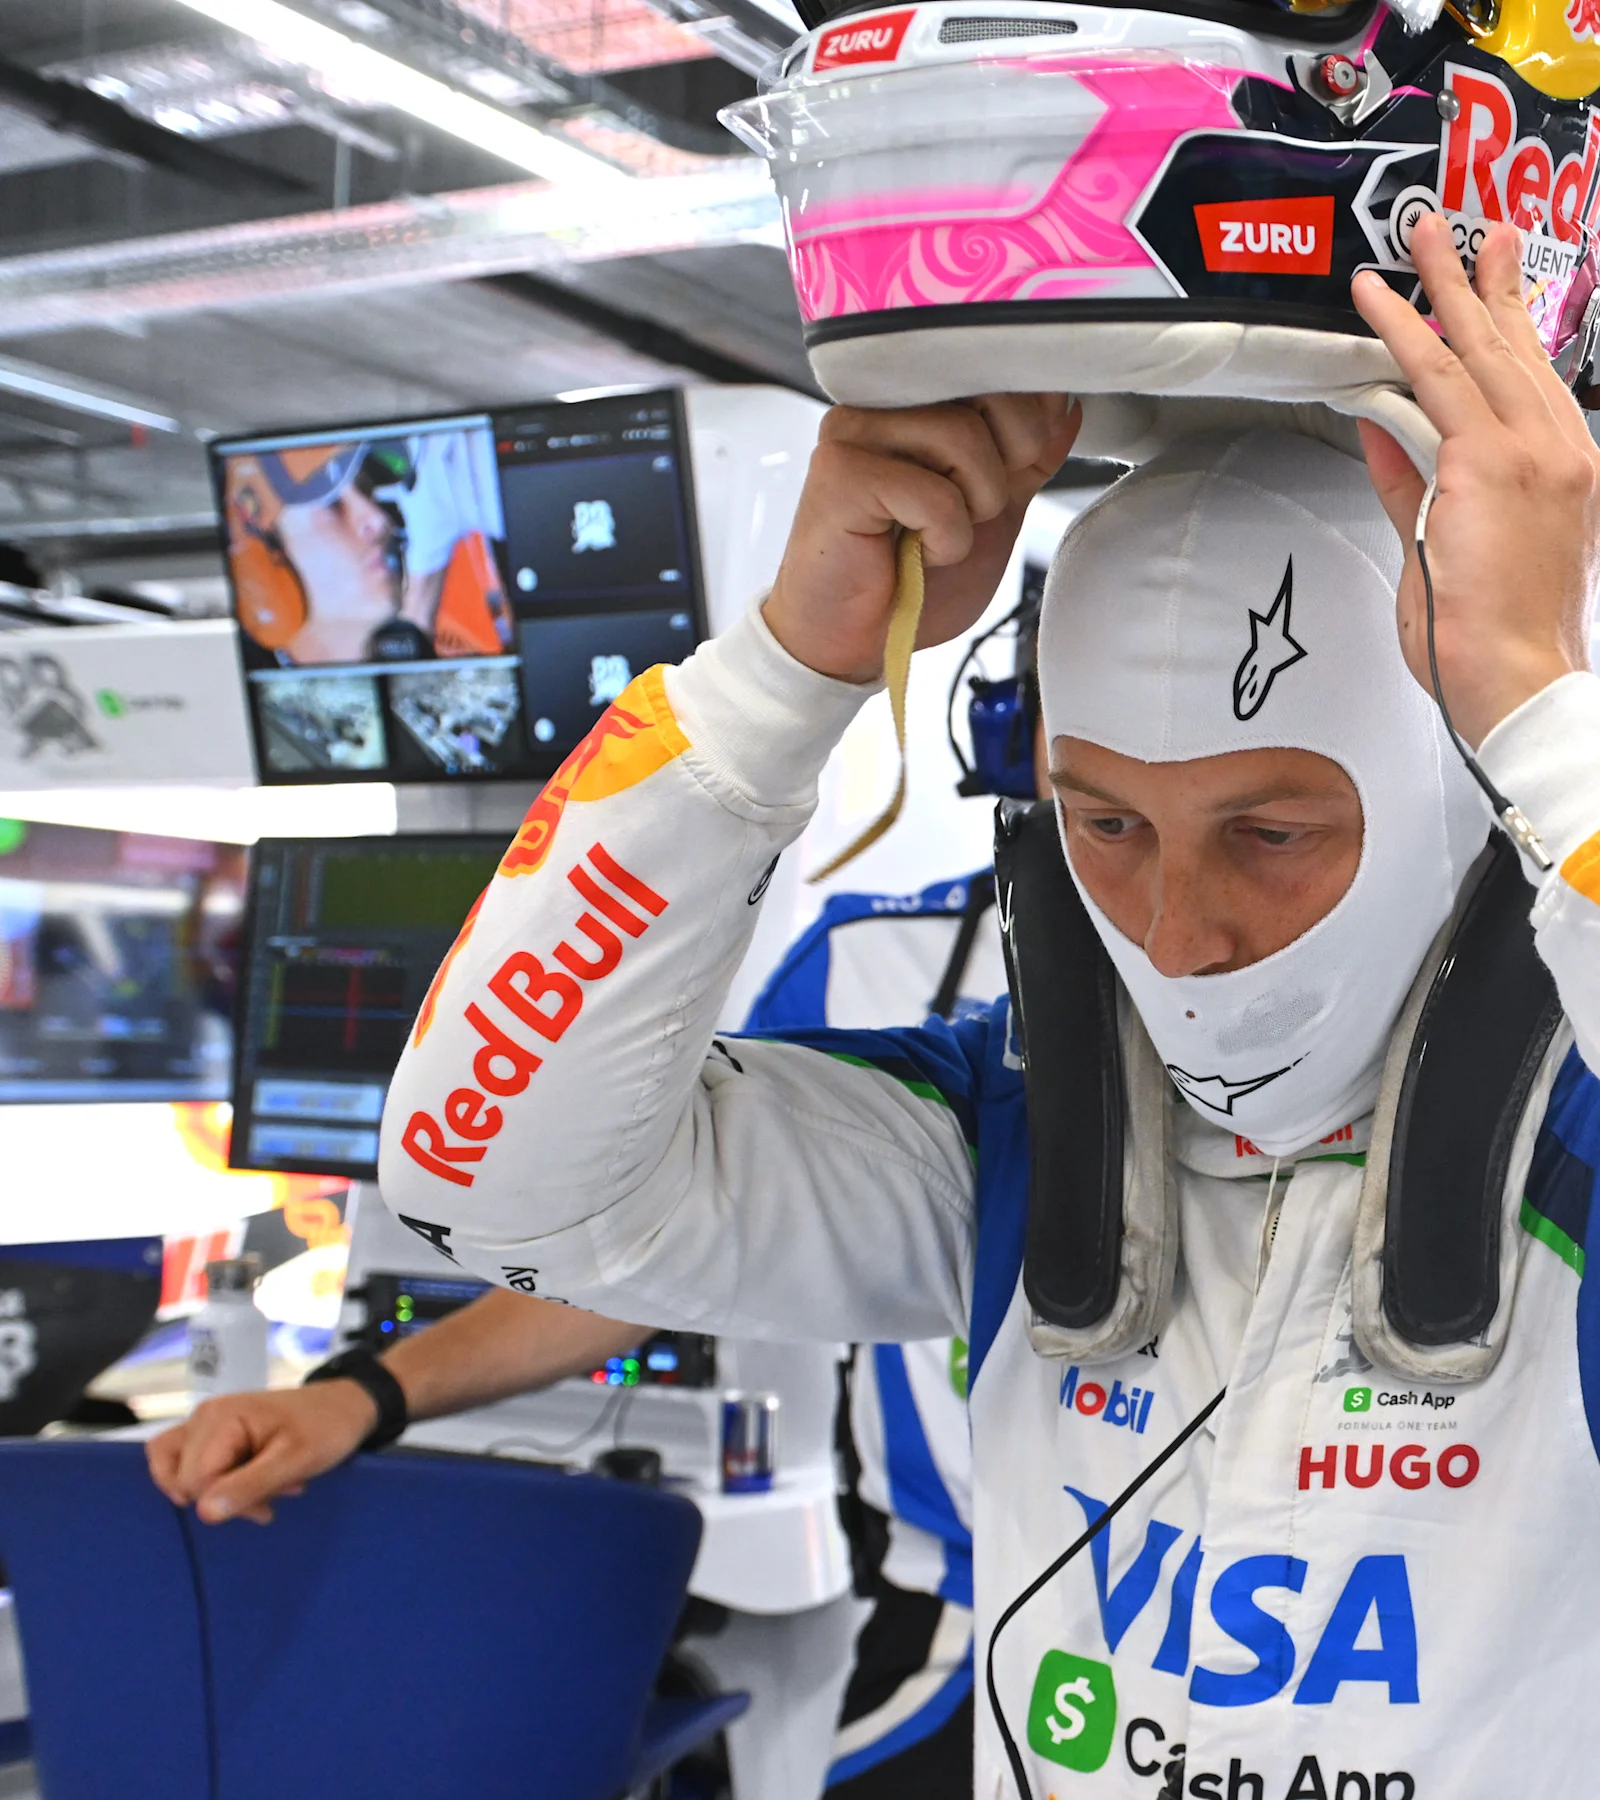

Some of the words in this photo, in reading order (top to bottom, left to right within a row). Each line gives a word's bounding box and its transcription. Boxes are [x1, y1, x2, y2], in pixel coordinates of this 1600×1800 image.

[823, 26, 894, 57] ZURU
[1219, 221, 1316, 256] ZURU
[1377, 1391, 1418, 1407] Cash
[1421, 1392, 1456, 1410] App
[1337, 1421, 1393, 1432] FORMULA
[1427, 1420, 1458, 1431] TEAM
[1298, 1444, 1480, 1490] HUGO
[1063, 1484, 1421, 1708] VISA
